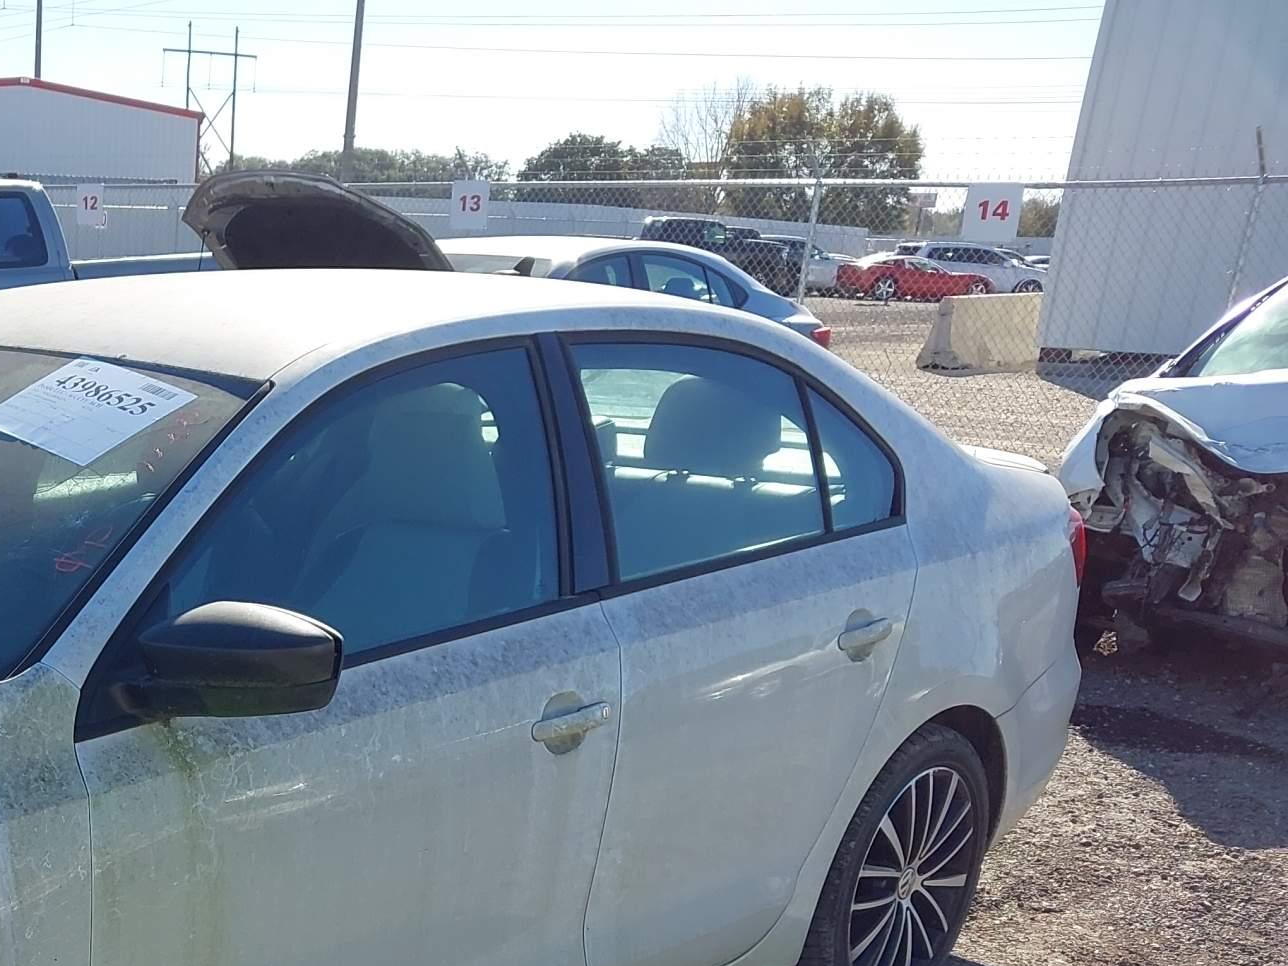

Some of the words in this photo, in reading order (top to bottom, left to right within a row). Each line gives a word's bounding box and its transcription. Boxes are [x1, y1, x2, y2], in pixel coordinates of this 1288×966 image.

[82, 195, 98, 210] 12
[459, 194, 481, 212] 13
[978, 200, 1010, 221] 14
[55, 374, 156, 416] 43986525
